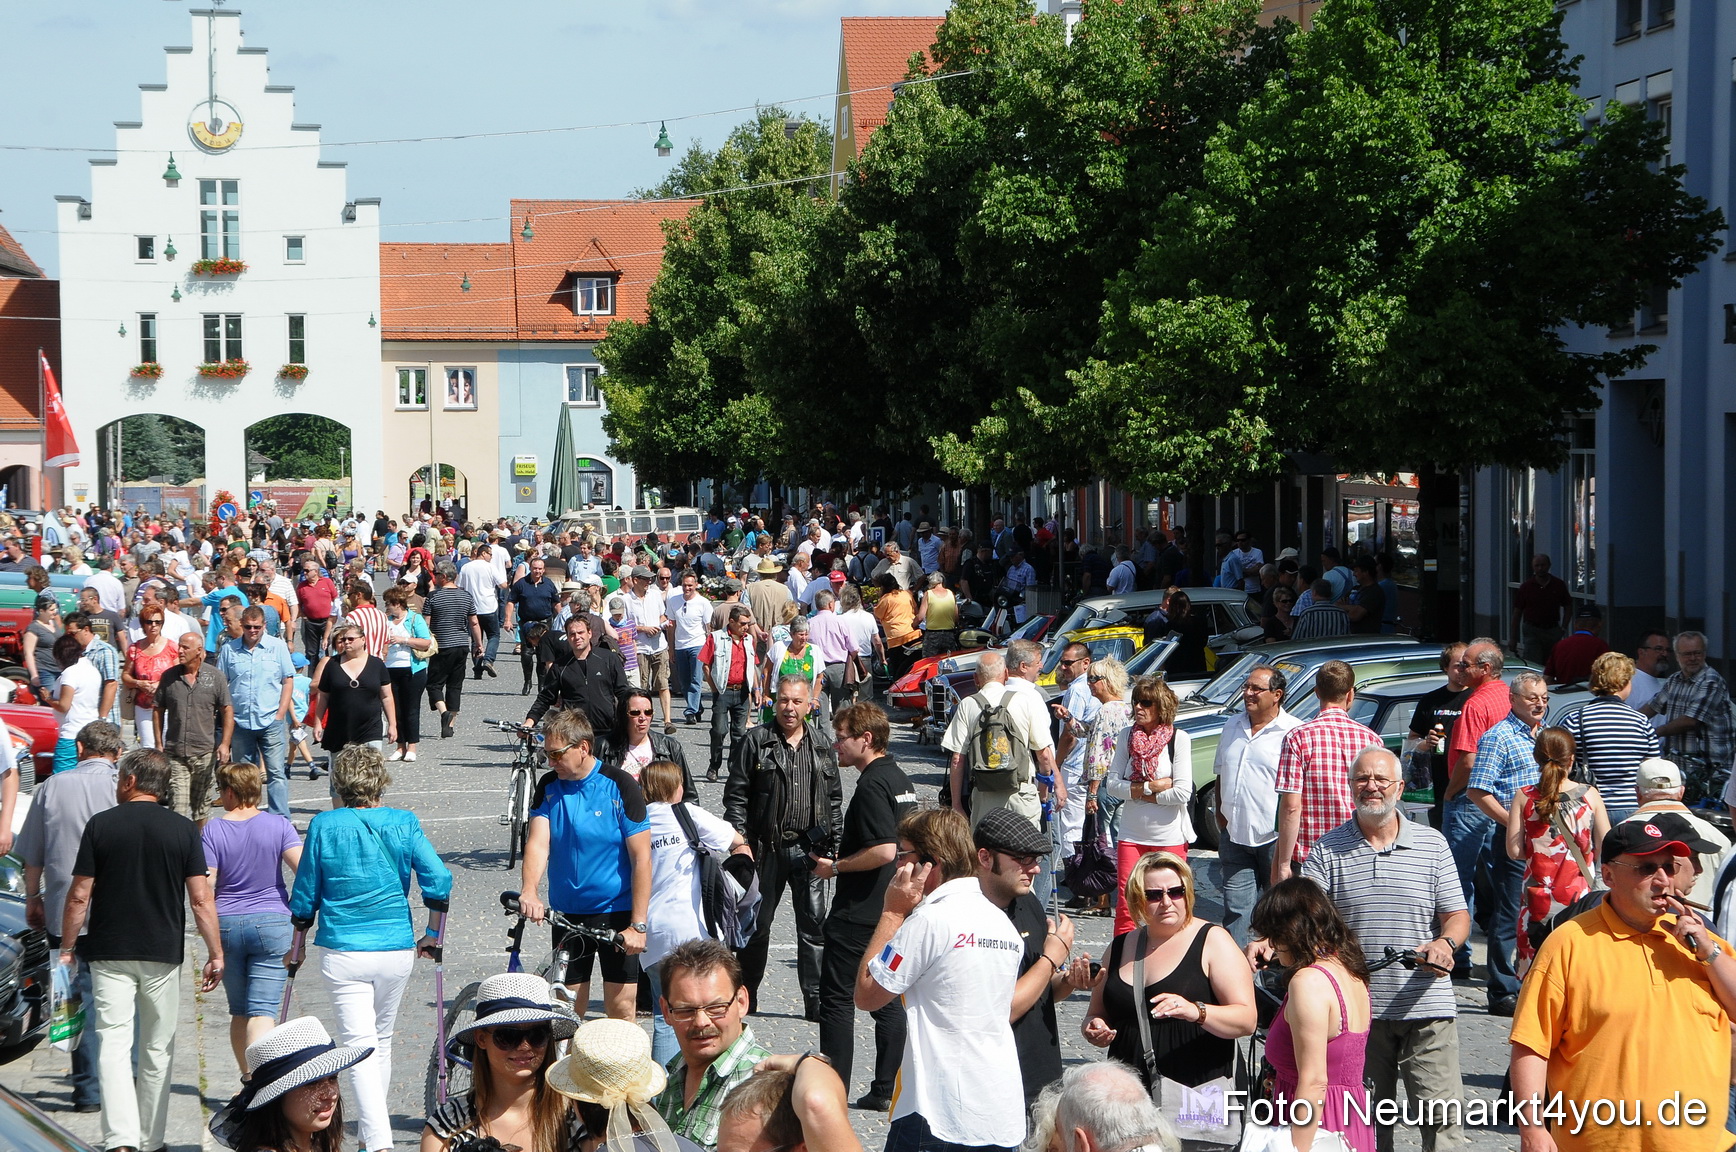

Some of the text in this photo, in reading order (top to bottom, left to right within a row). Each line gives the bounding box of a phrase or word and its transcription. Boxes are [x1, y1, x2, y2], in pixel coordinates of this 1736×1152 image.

[875, 531, 881, 540] P
[954, 933, 976, 948] 24
[978, 938, 998, 949] HEURES
[1000, 940, 1008, 950] DU
